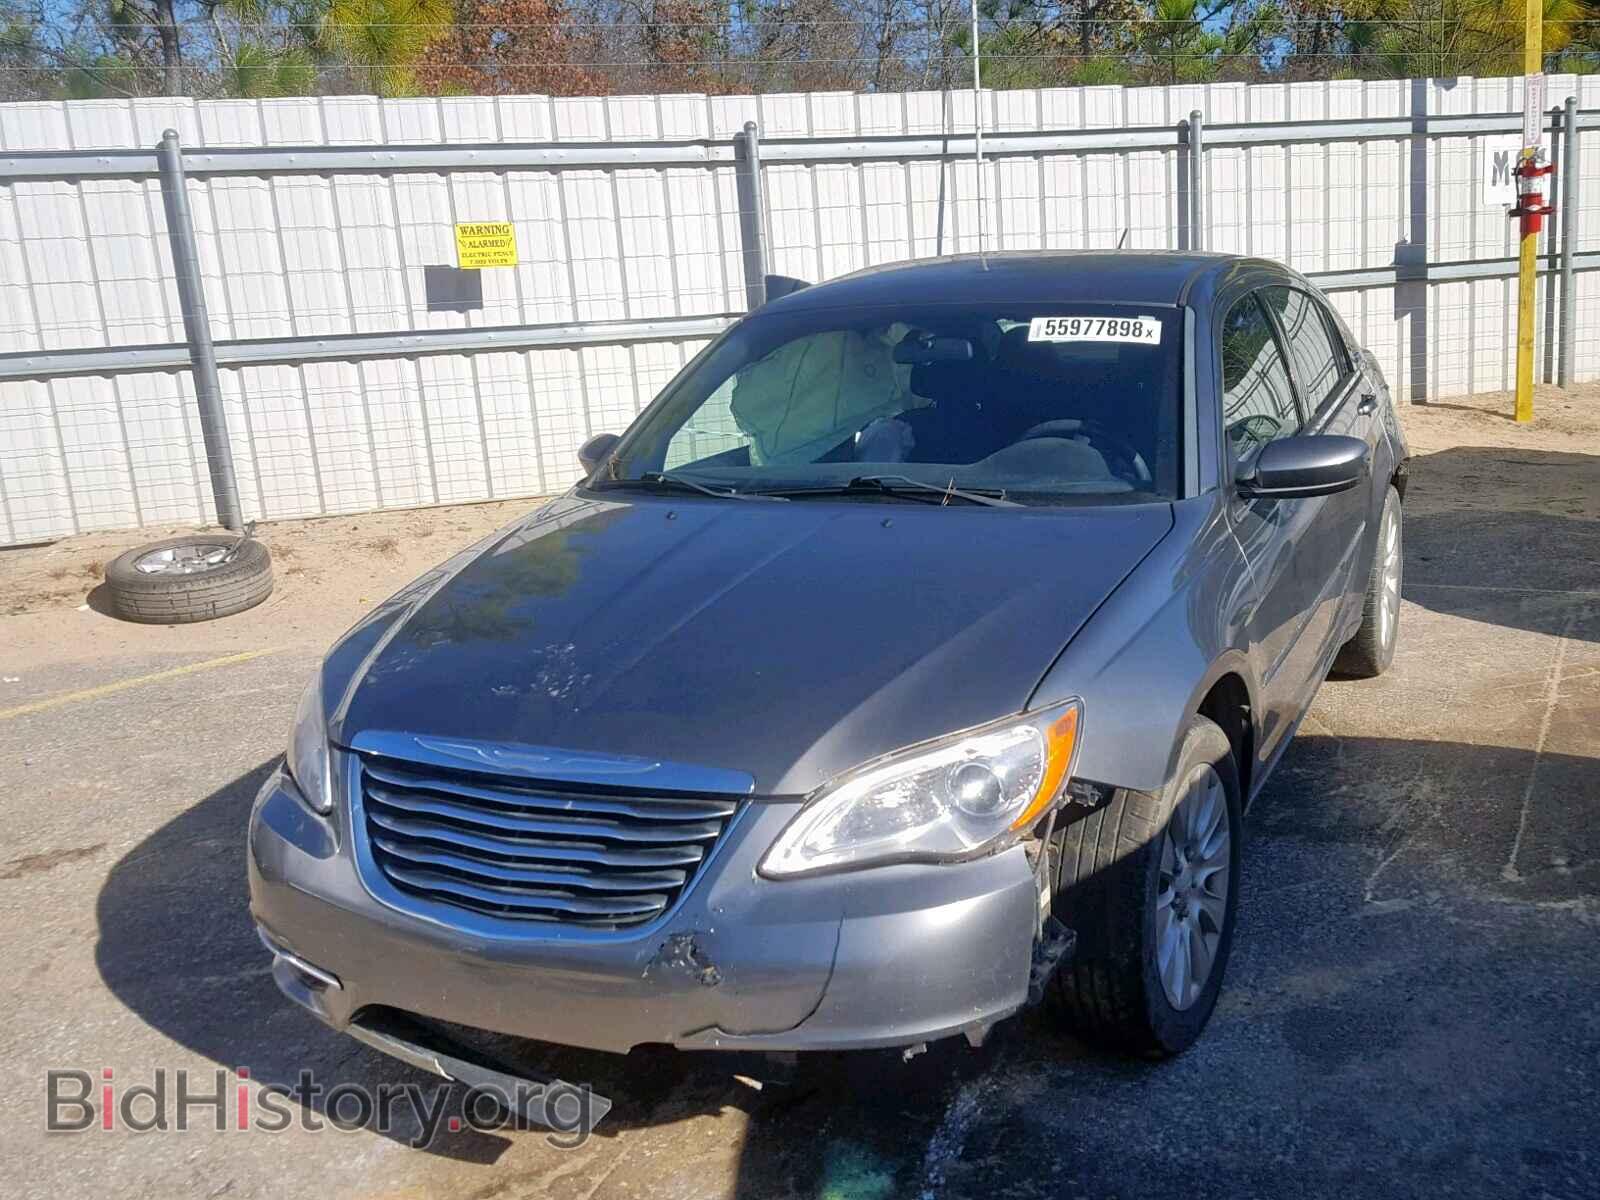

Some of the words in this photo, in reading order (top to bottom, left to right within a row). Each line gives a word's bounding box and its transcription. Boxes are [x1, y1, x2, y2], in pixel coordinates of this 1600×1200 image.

[459, 224, 510, 235] WARNING
[467, 240, 506, 249] ALARMED
[1045, 319, 1144, 338] 55977898
